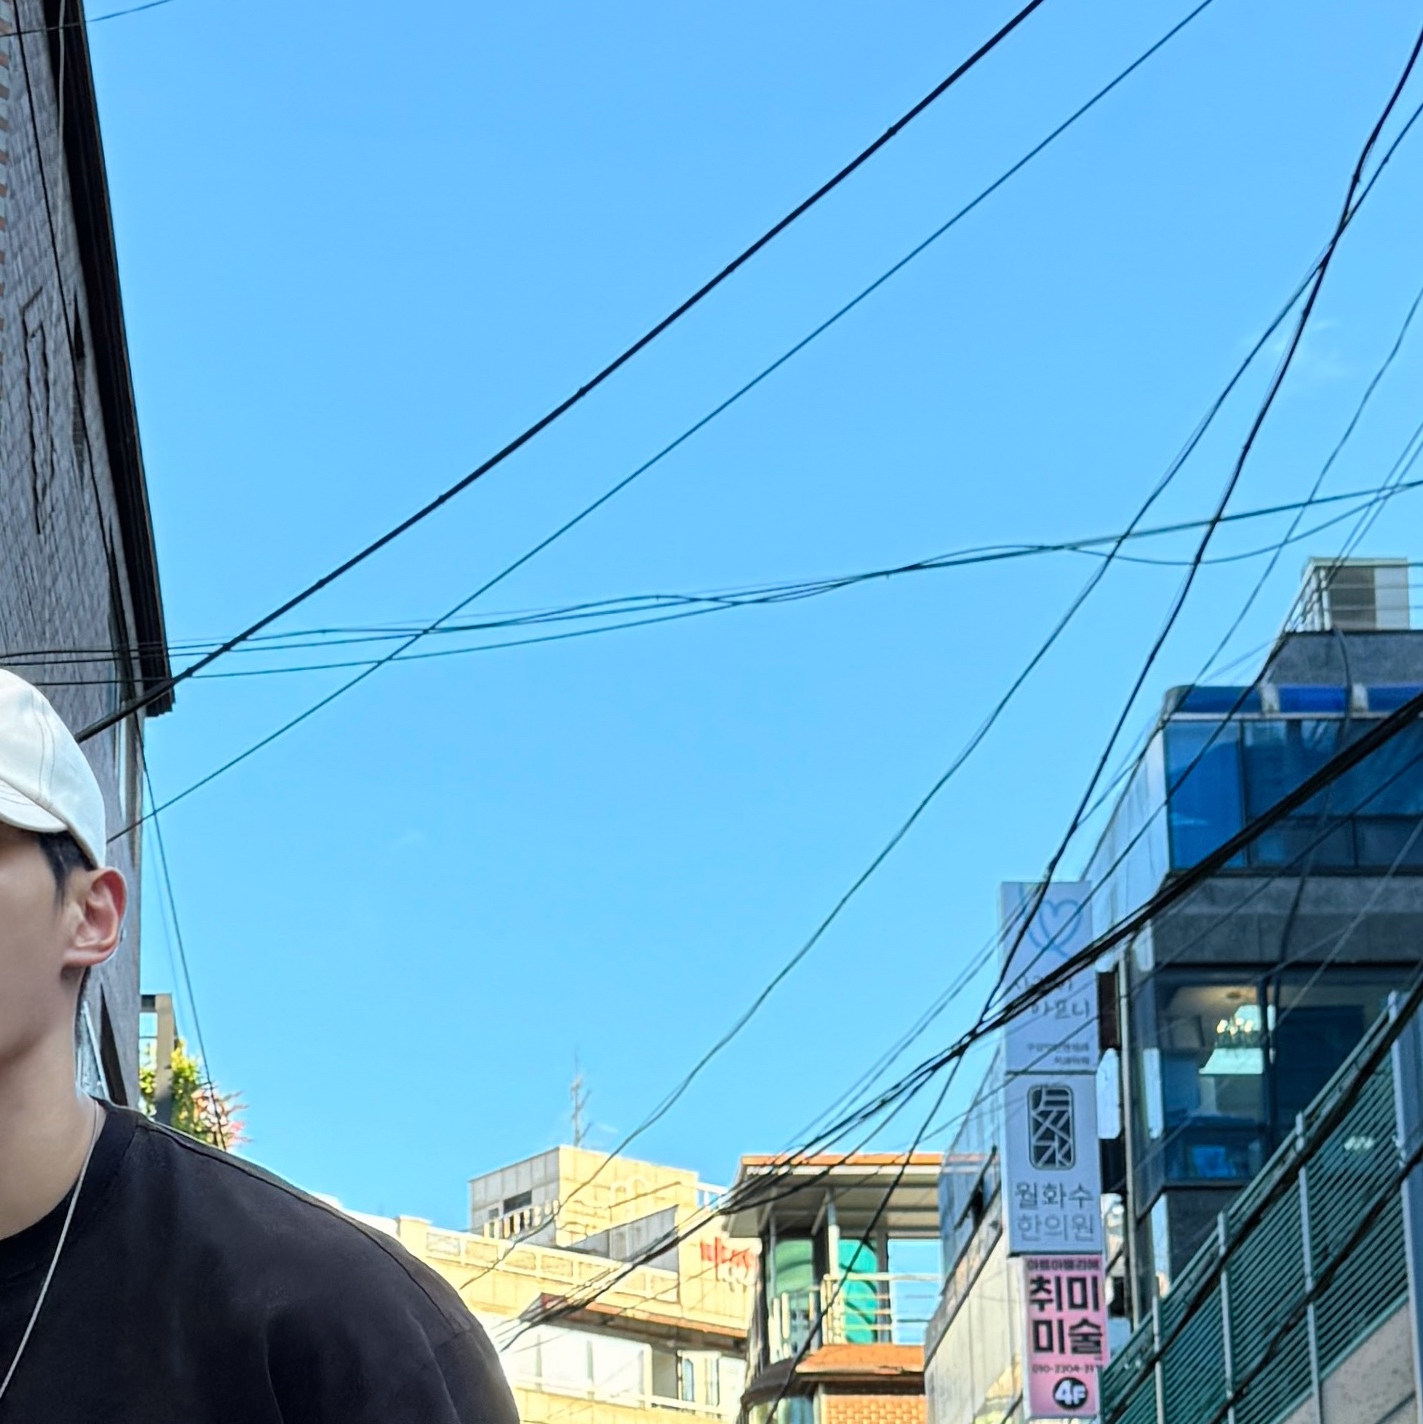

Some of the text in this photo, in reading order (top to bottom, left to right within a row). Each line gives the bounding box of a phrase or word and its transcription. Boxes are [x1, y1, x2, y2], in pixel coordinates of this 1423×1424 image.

[1015, 1182, 1094, 1210] 월화수
[1017, 1213, 1095, 1242] 한의원
[1029, 1275, 1099, 1312] 취미
[1033, 1317, 1103, 1355] 미술
[1054, 1380, 1086, 1405] 4F
